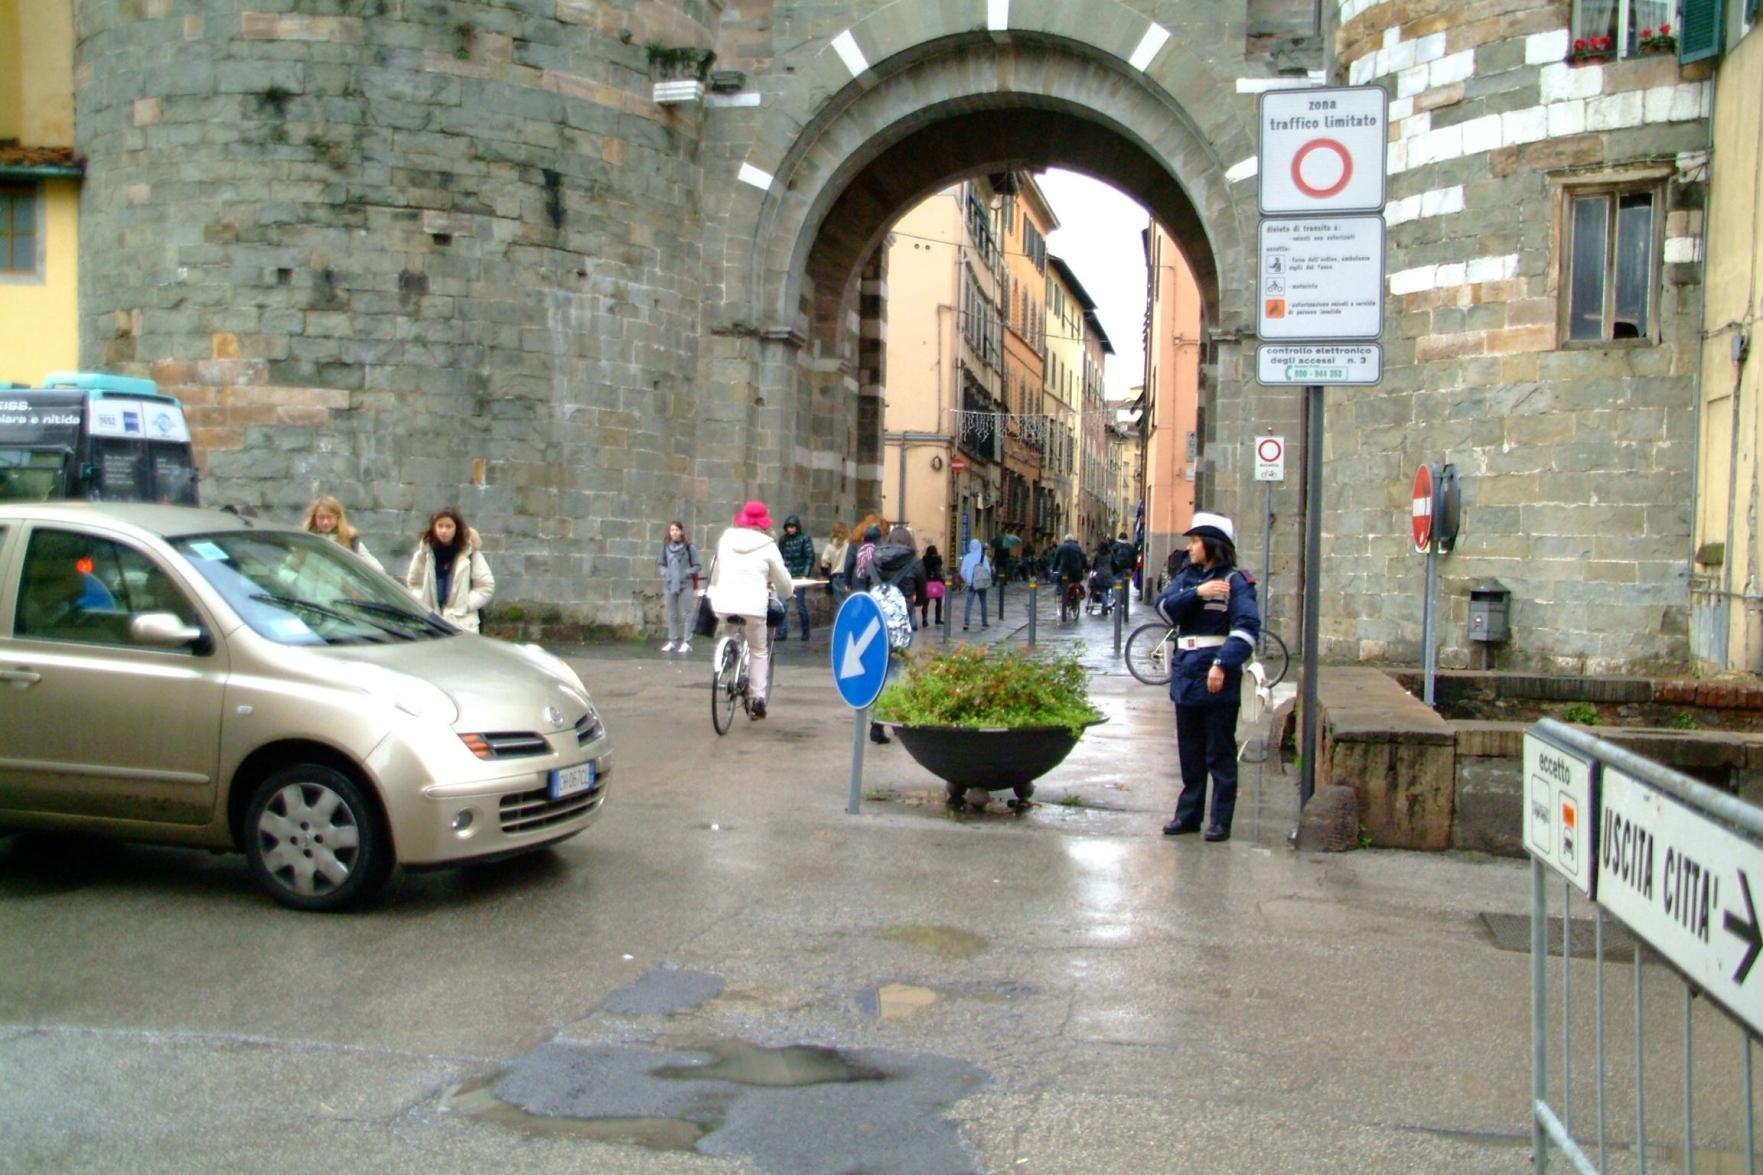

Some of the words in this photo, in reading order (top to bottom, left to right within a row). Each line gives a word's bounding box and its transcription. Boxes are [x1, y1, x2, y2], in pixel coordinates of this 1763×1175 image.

[1308, 100, 1337, 111] zona
[1270, 117, 1319, 131] traffico
[1325, 114, 1377, 128] limitato
[1266, 347, 1313, 355] controllo
[1315, 347, 1372, 355] elettronico
[1270, 356, 1296, 365] degli
[1538, 751, 1571, 786] eccetto
[1602, 807, 1654, 901] USCITA
[1663, 846, 1719, 944] CITTA'
